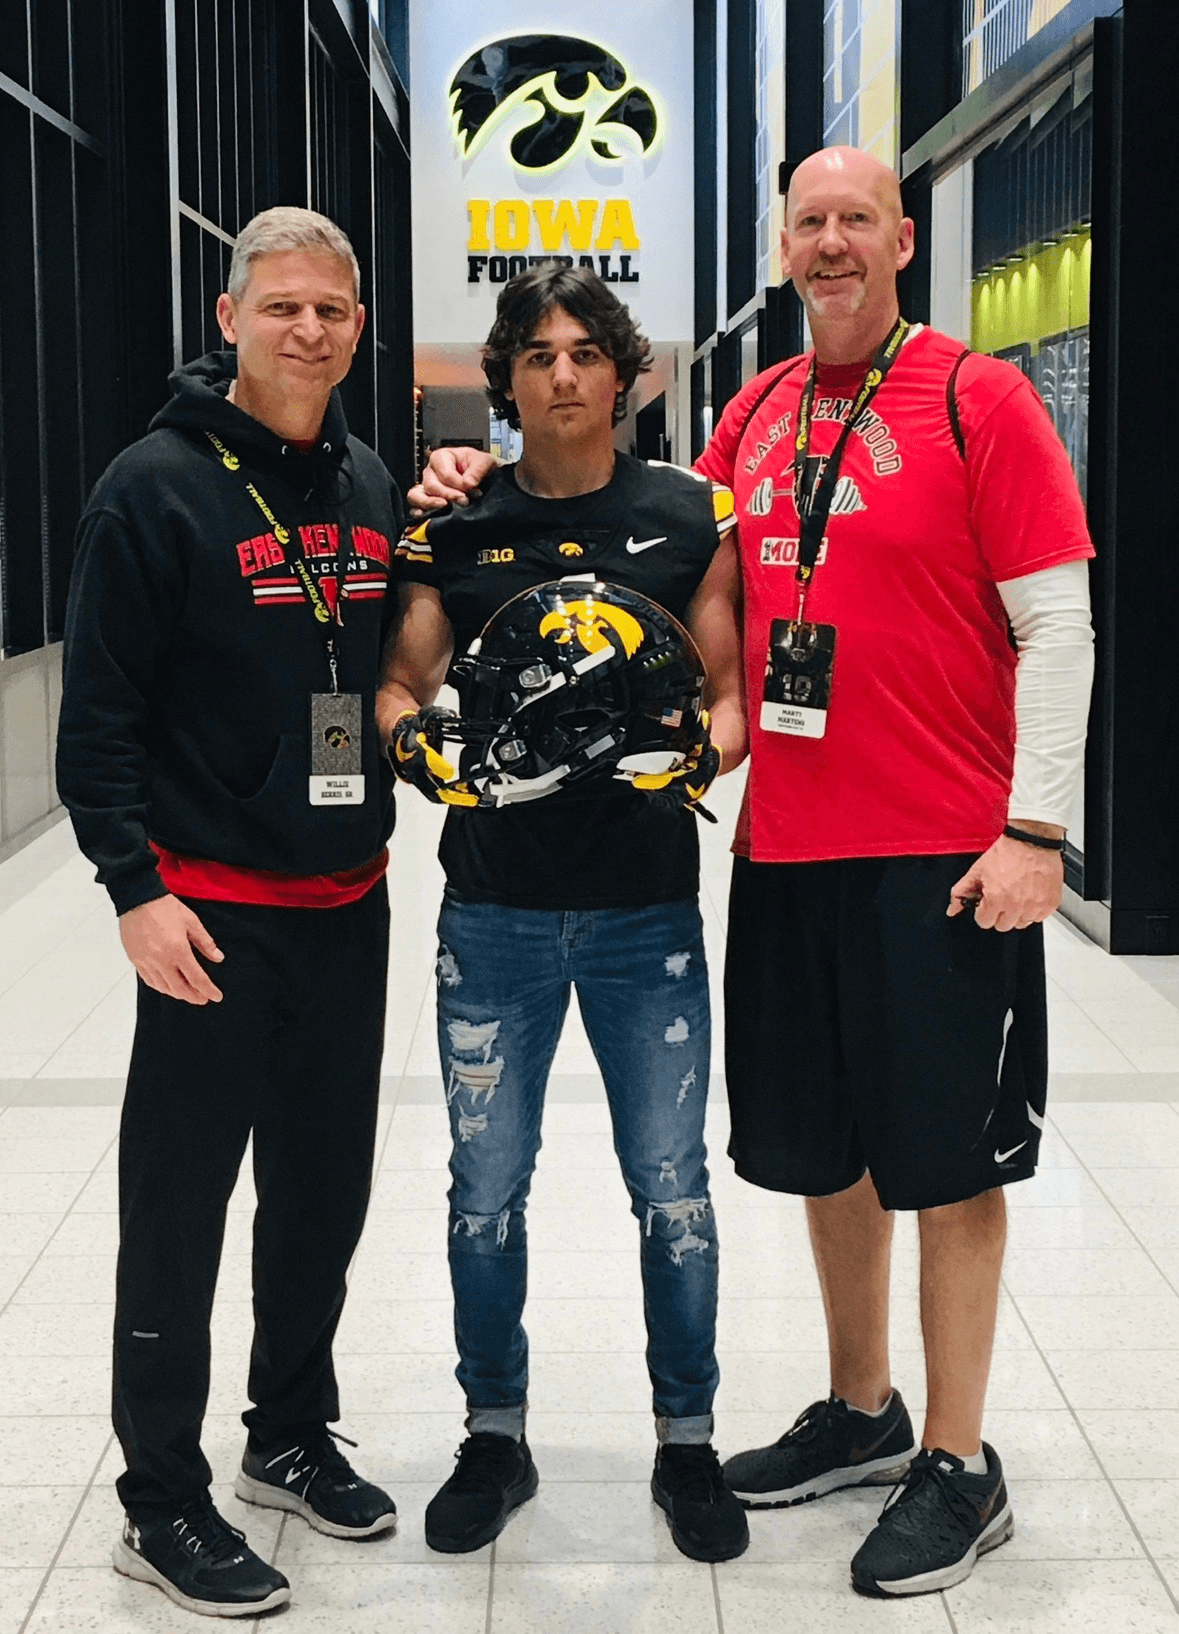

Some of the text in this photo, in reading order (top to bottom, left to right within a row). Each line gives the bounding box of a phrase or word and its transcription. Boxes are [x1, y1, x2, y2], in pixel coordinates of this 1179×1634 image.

[466, 198, 640, 252] IOWA
[467, 255, 639, 282] FOOALL
[744, 397, 902, 477] EAST ENWOOD
[236, 532, 286, 577] EAS
